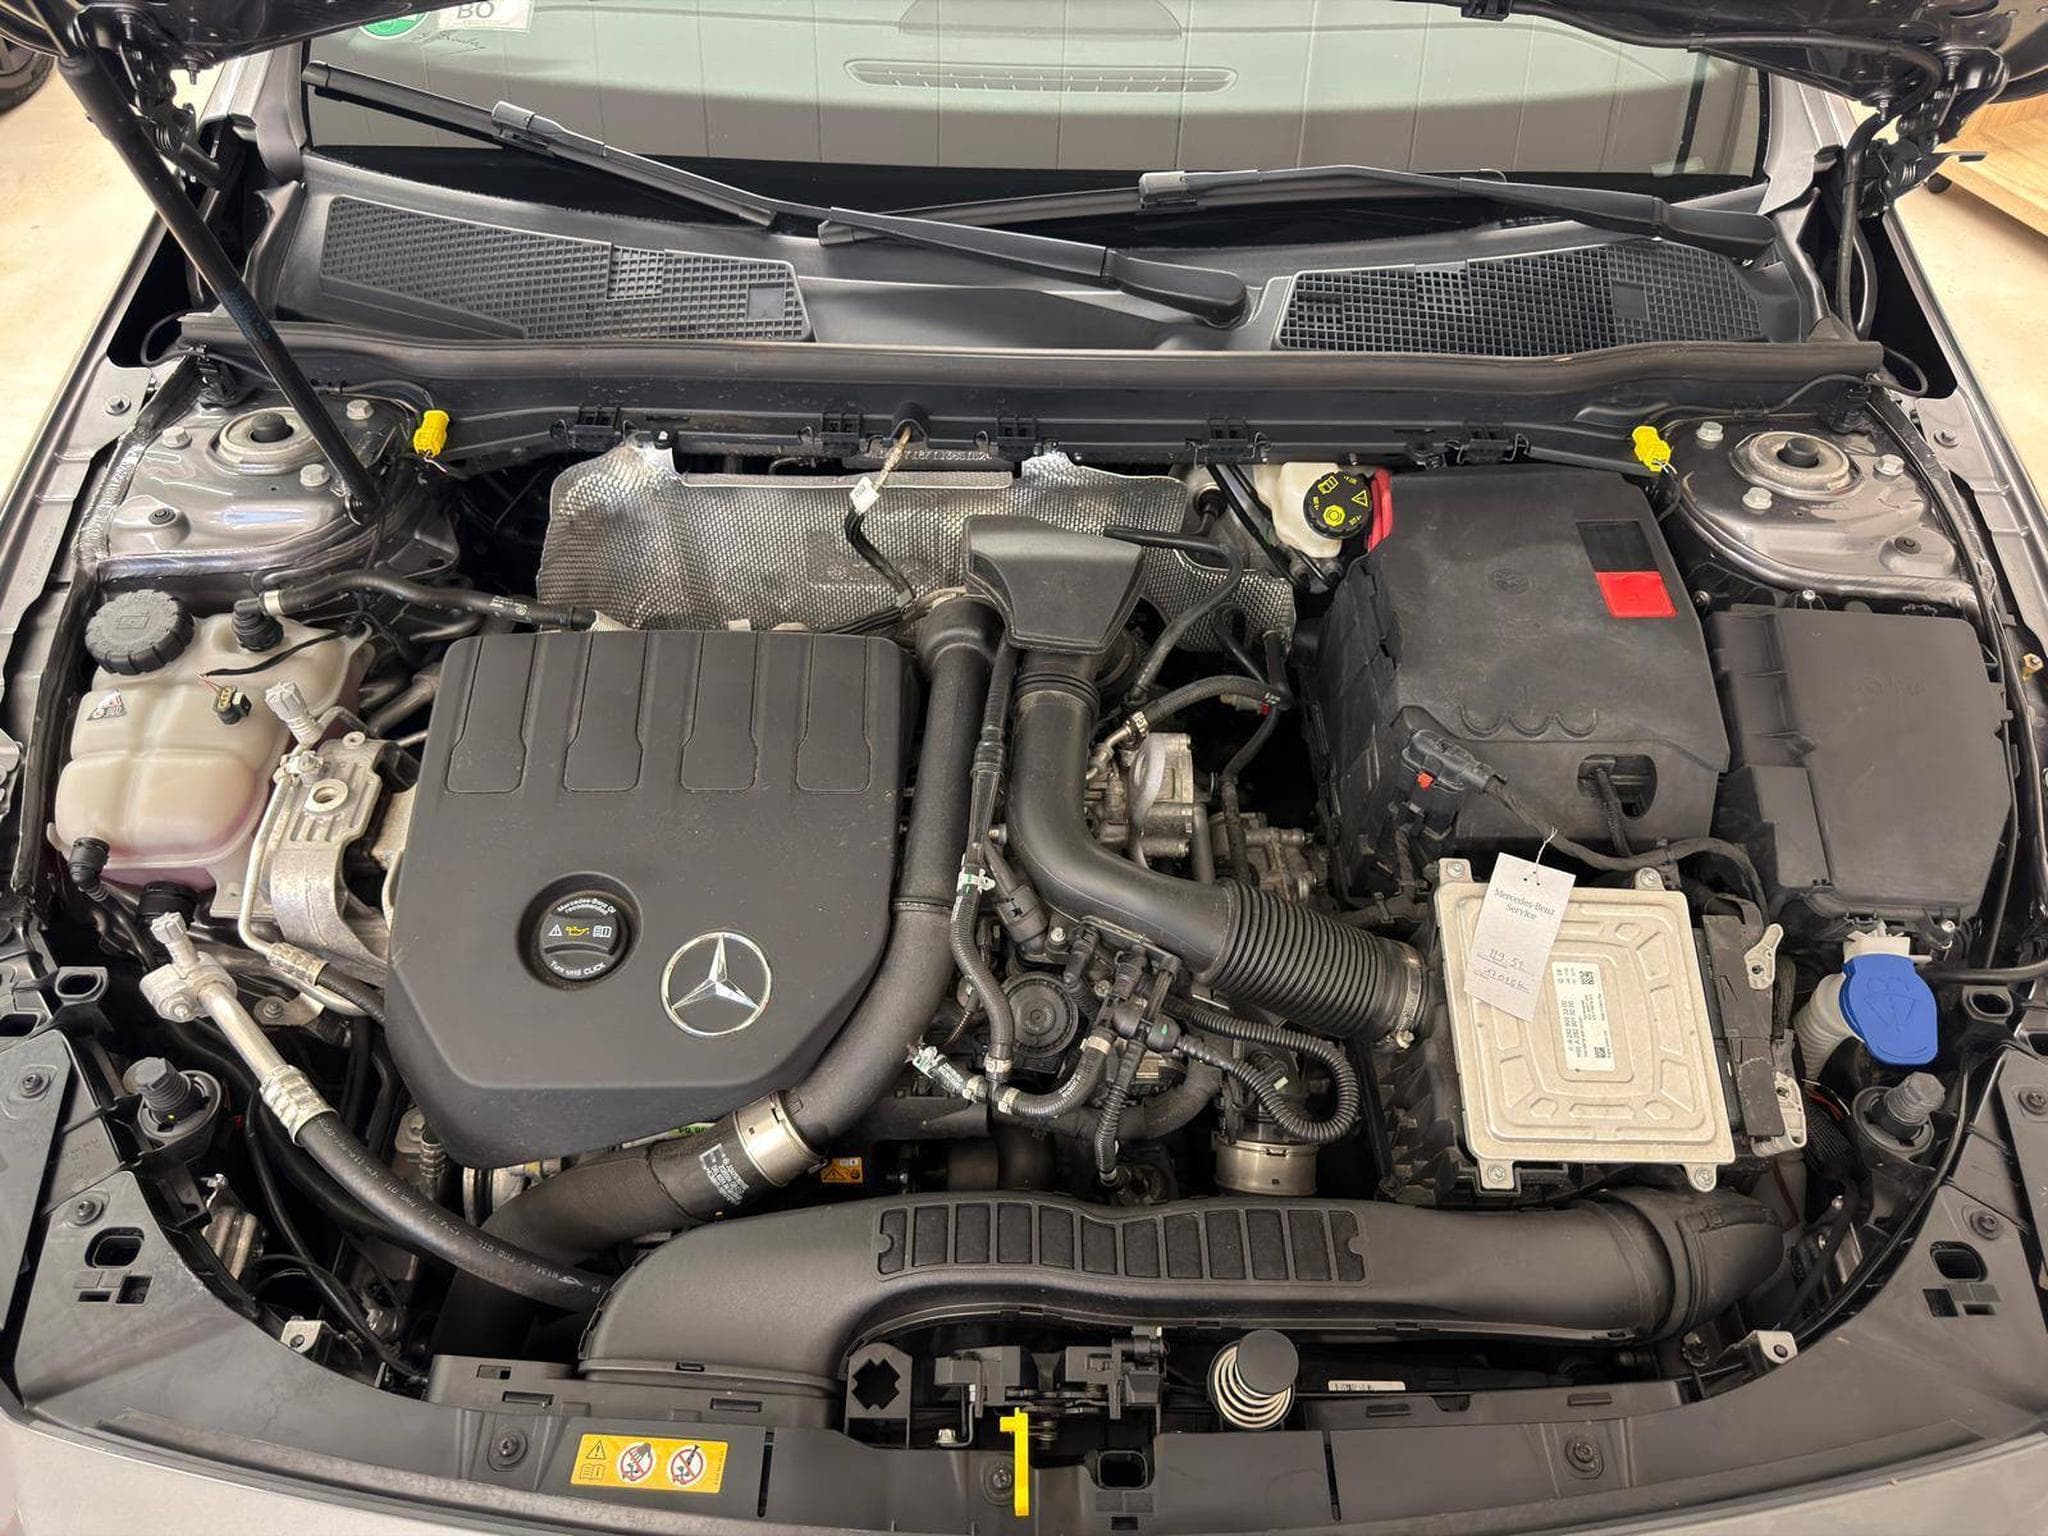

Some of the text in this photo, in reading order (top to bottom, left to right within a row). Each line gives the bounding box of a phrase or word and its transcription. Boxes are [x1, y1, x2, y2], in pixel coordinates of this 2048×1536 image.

[1494, 888, 1556, 916] Mercedes-Benz
[1505, 903, 1537, 920] Service
[550, 960, 565, 973] Turn
[583, 961, 606, 976] CLICK
